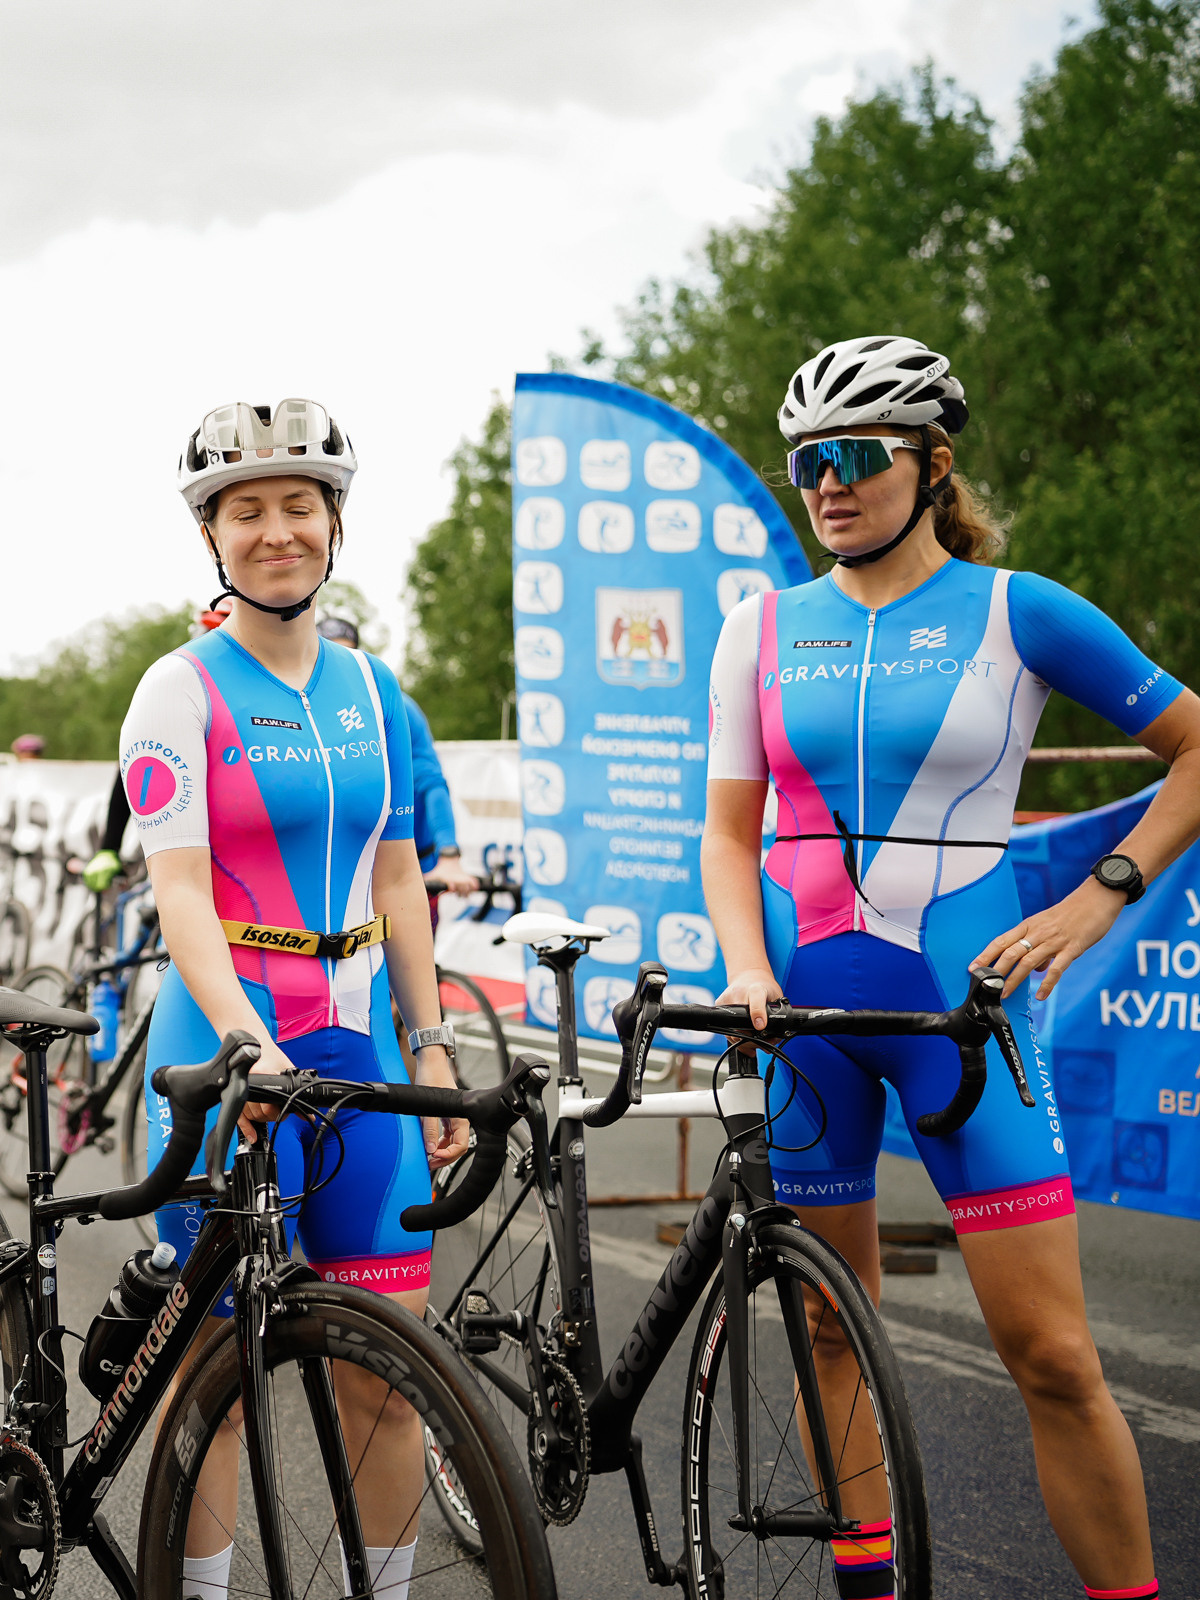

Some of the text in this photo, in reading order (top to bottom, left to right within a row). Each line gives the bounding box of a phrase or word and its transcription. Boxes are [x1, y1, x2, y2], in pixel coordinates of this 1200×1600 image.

[779, 657, 998, 685] GRAVITYSPORT
[241, 926, 311, 950] isostar
[635, 1021, 653, 1081] ULTEGRA
[1002, 1026, 1026, 1085] ULTEGRA
[952, 1189, 1065, 1221] GRAVITYSPORT
[85, 1281, 190, 1465] cannondale
